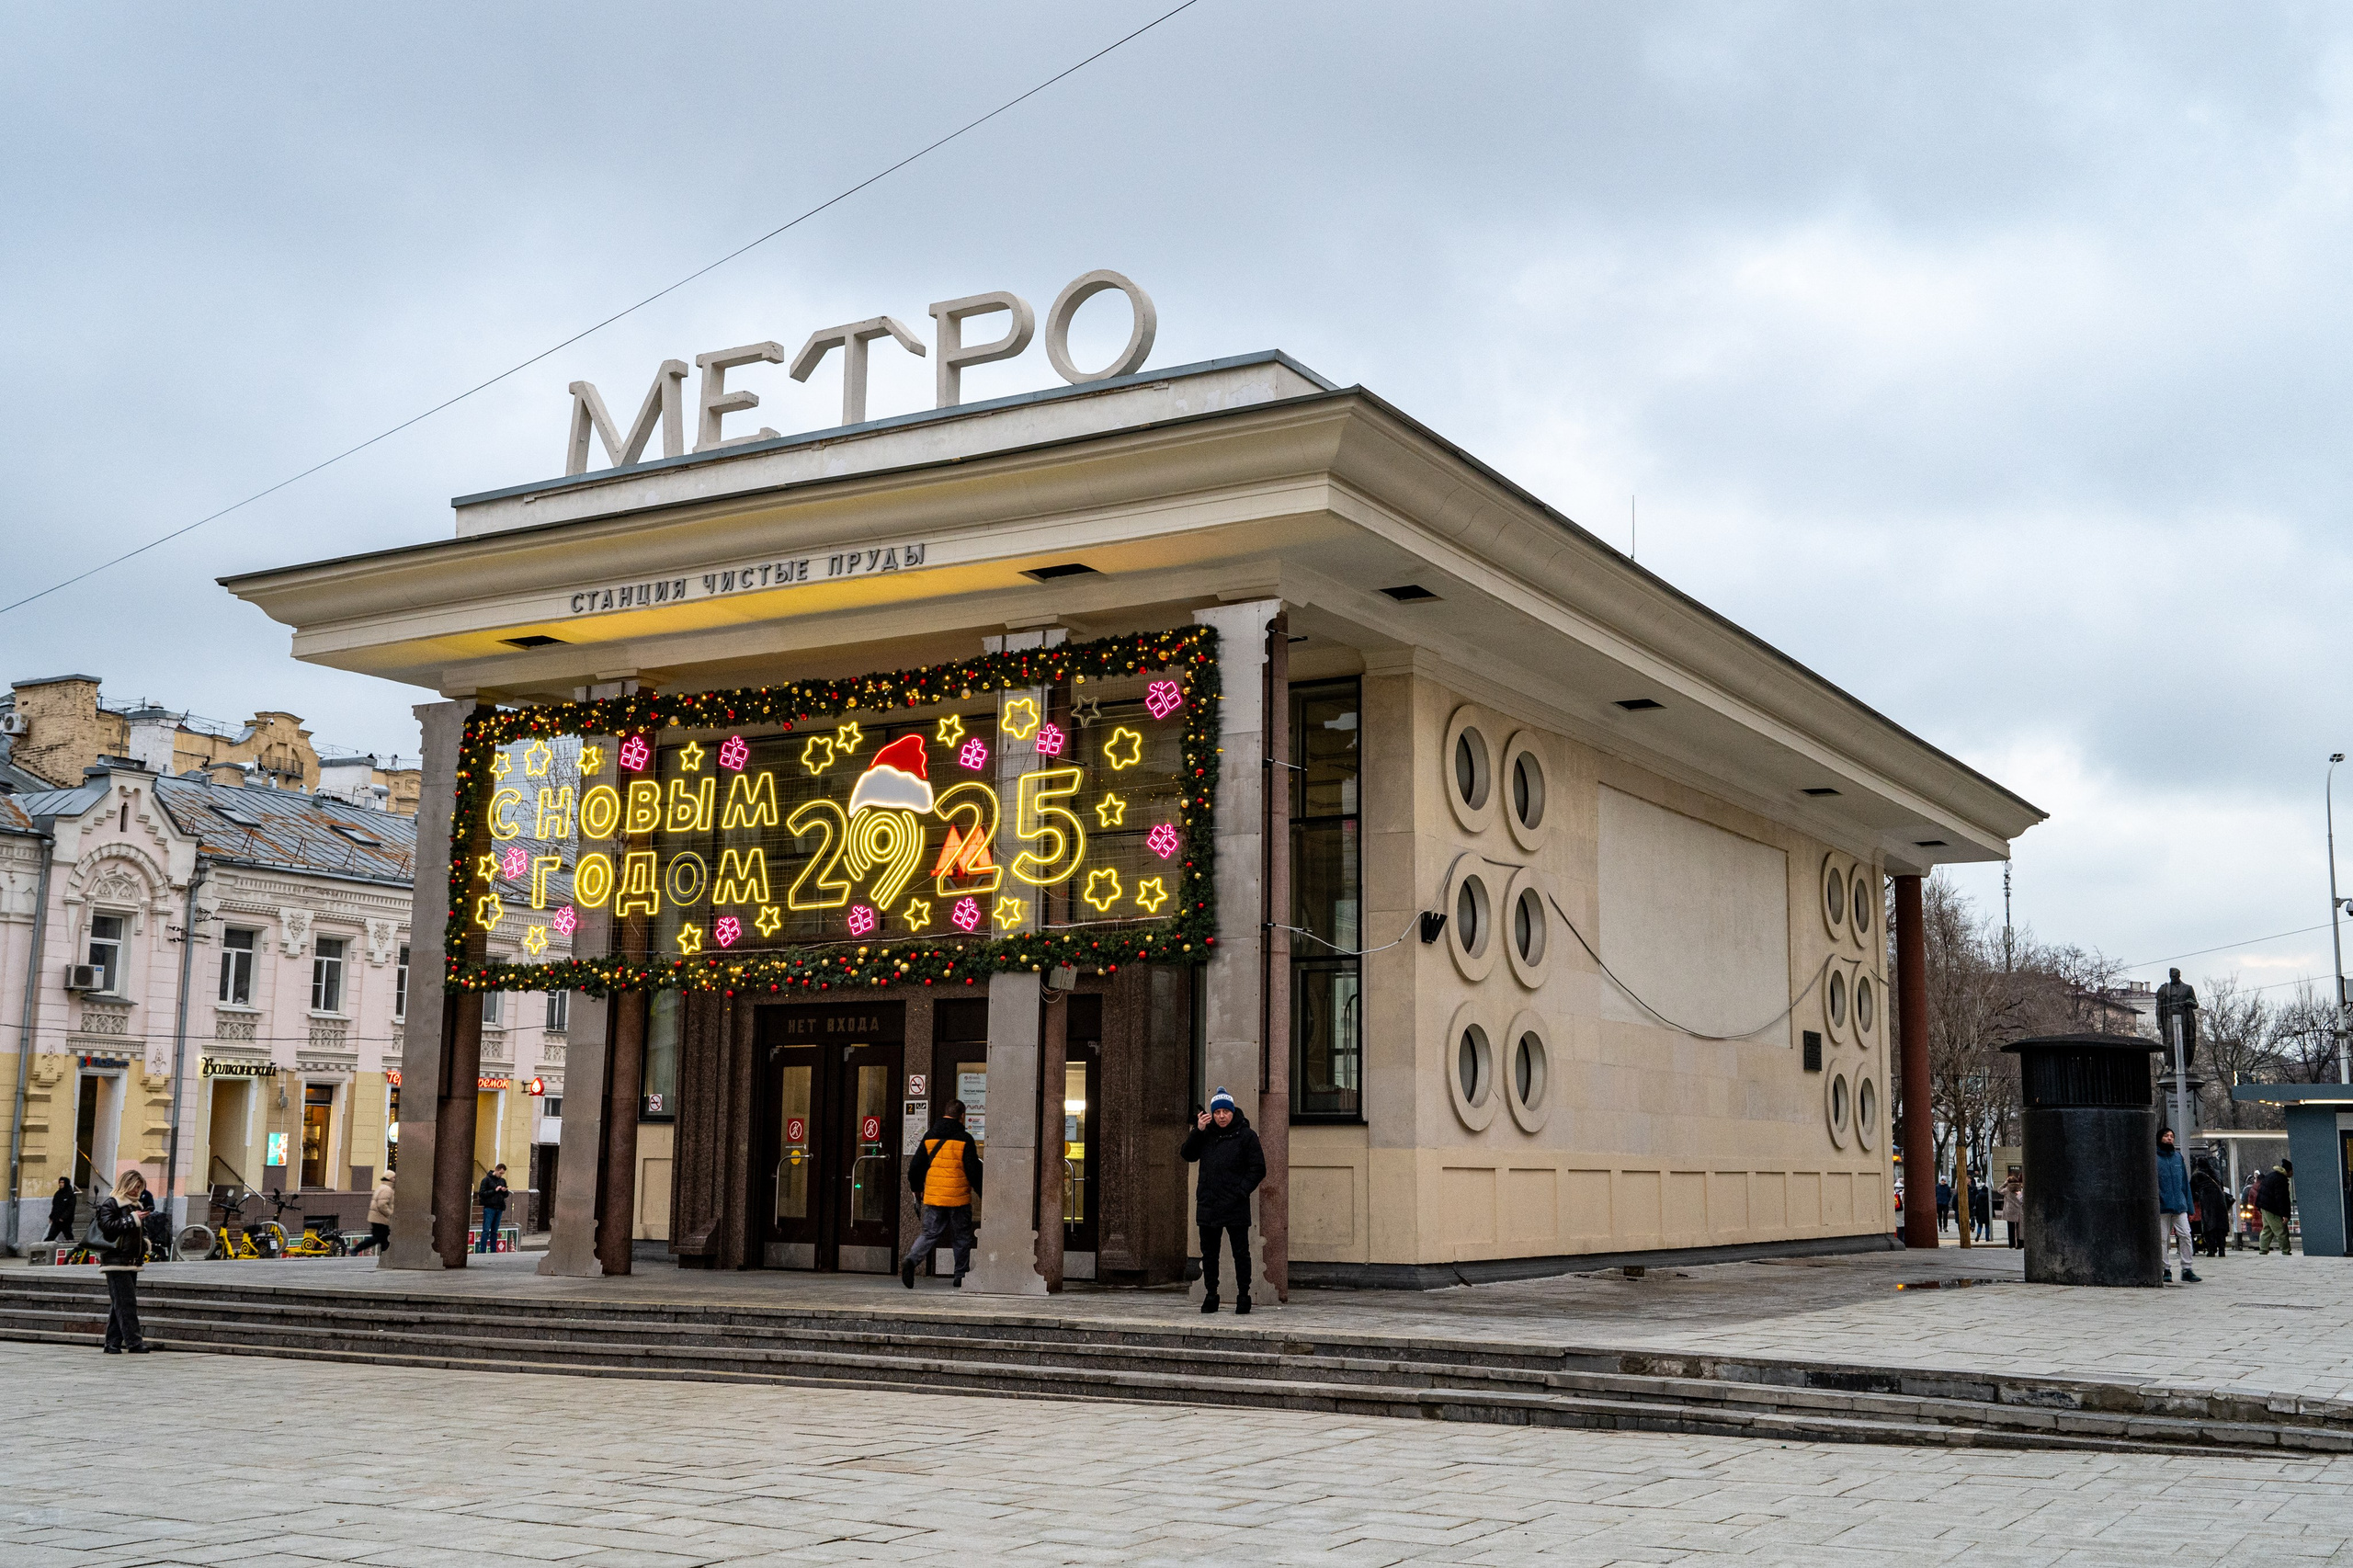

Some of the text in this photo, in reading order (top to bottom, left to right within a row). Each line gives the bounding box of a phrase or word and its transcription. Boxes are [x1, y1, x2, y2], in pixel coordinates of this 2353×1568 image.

[565, 269, 1158, 475] МЕТРО
[570, 542, 926, 613] СТАНЦИЯ ЧИСТЫЕ ПРУДЫ
[488, 771, 779, 840] С НОВЫМ
[531, 846, 770, 917] ГОДОМ
[788, 1017, 880, 1034] НЕТ ВХОДА
[201, 1057, 277, 1077] Волконский
[908, 1104, 914, 1112] 2
